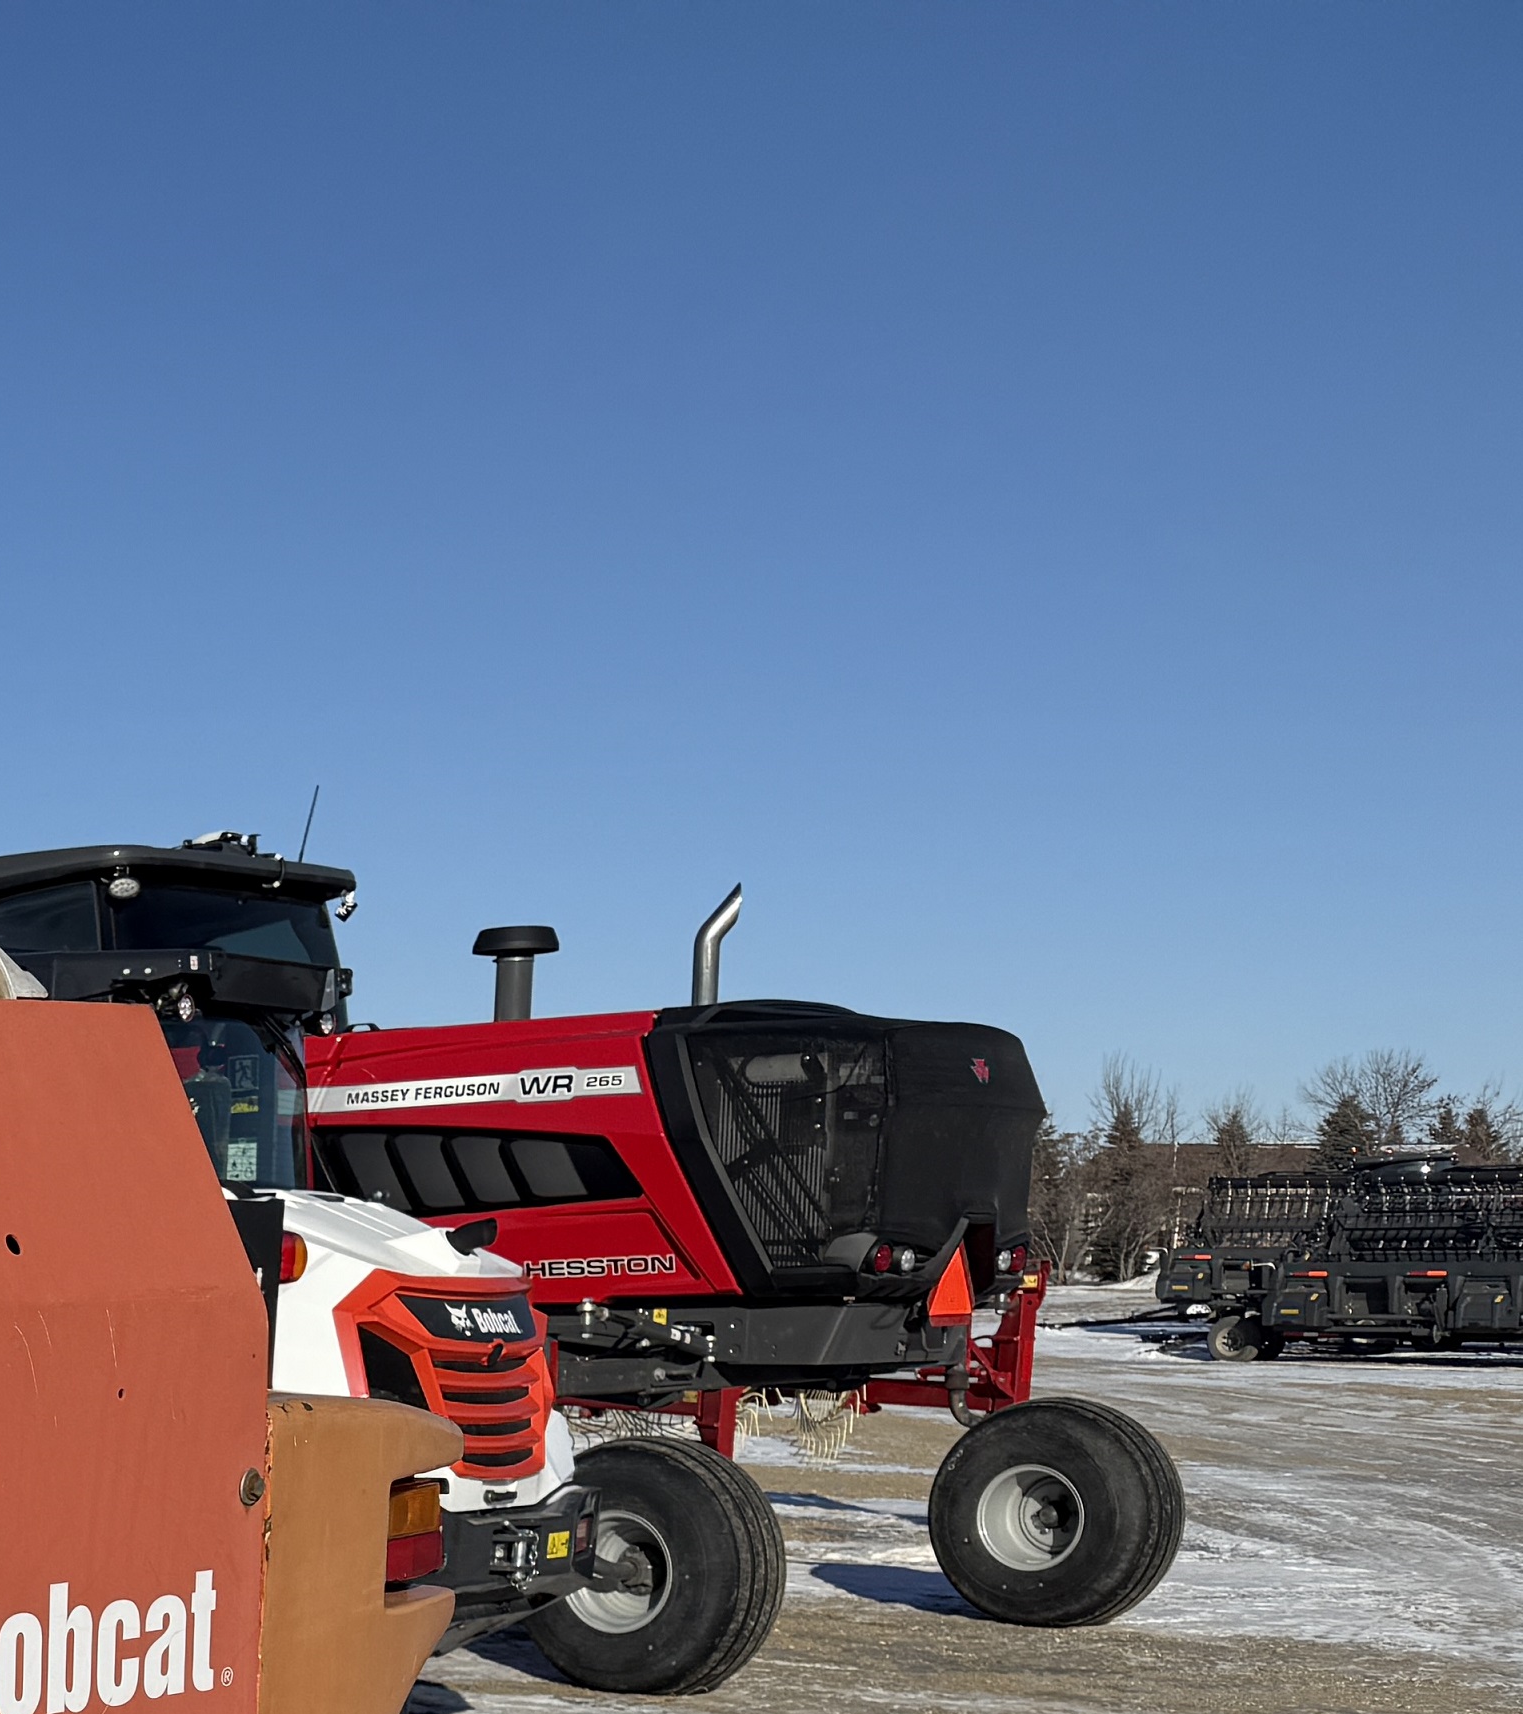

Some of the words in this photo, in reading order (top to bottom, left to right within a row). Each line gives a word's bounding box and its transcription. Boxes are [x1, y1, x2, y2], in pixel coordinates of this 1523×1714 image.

[346, 1088, 410, 1106] MASSEY
[414, 1081, 501, 1101] FERGUSON
[519, 1074, 574, 1096] WR
[585, 1075, 623, 1088] 265
[525, 1255, 675, 1279] HESSTON
[470, 1307, 521, 1335] Bobcat
